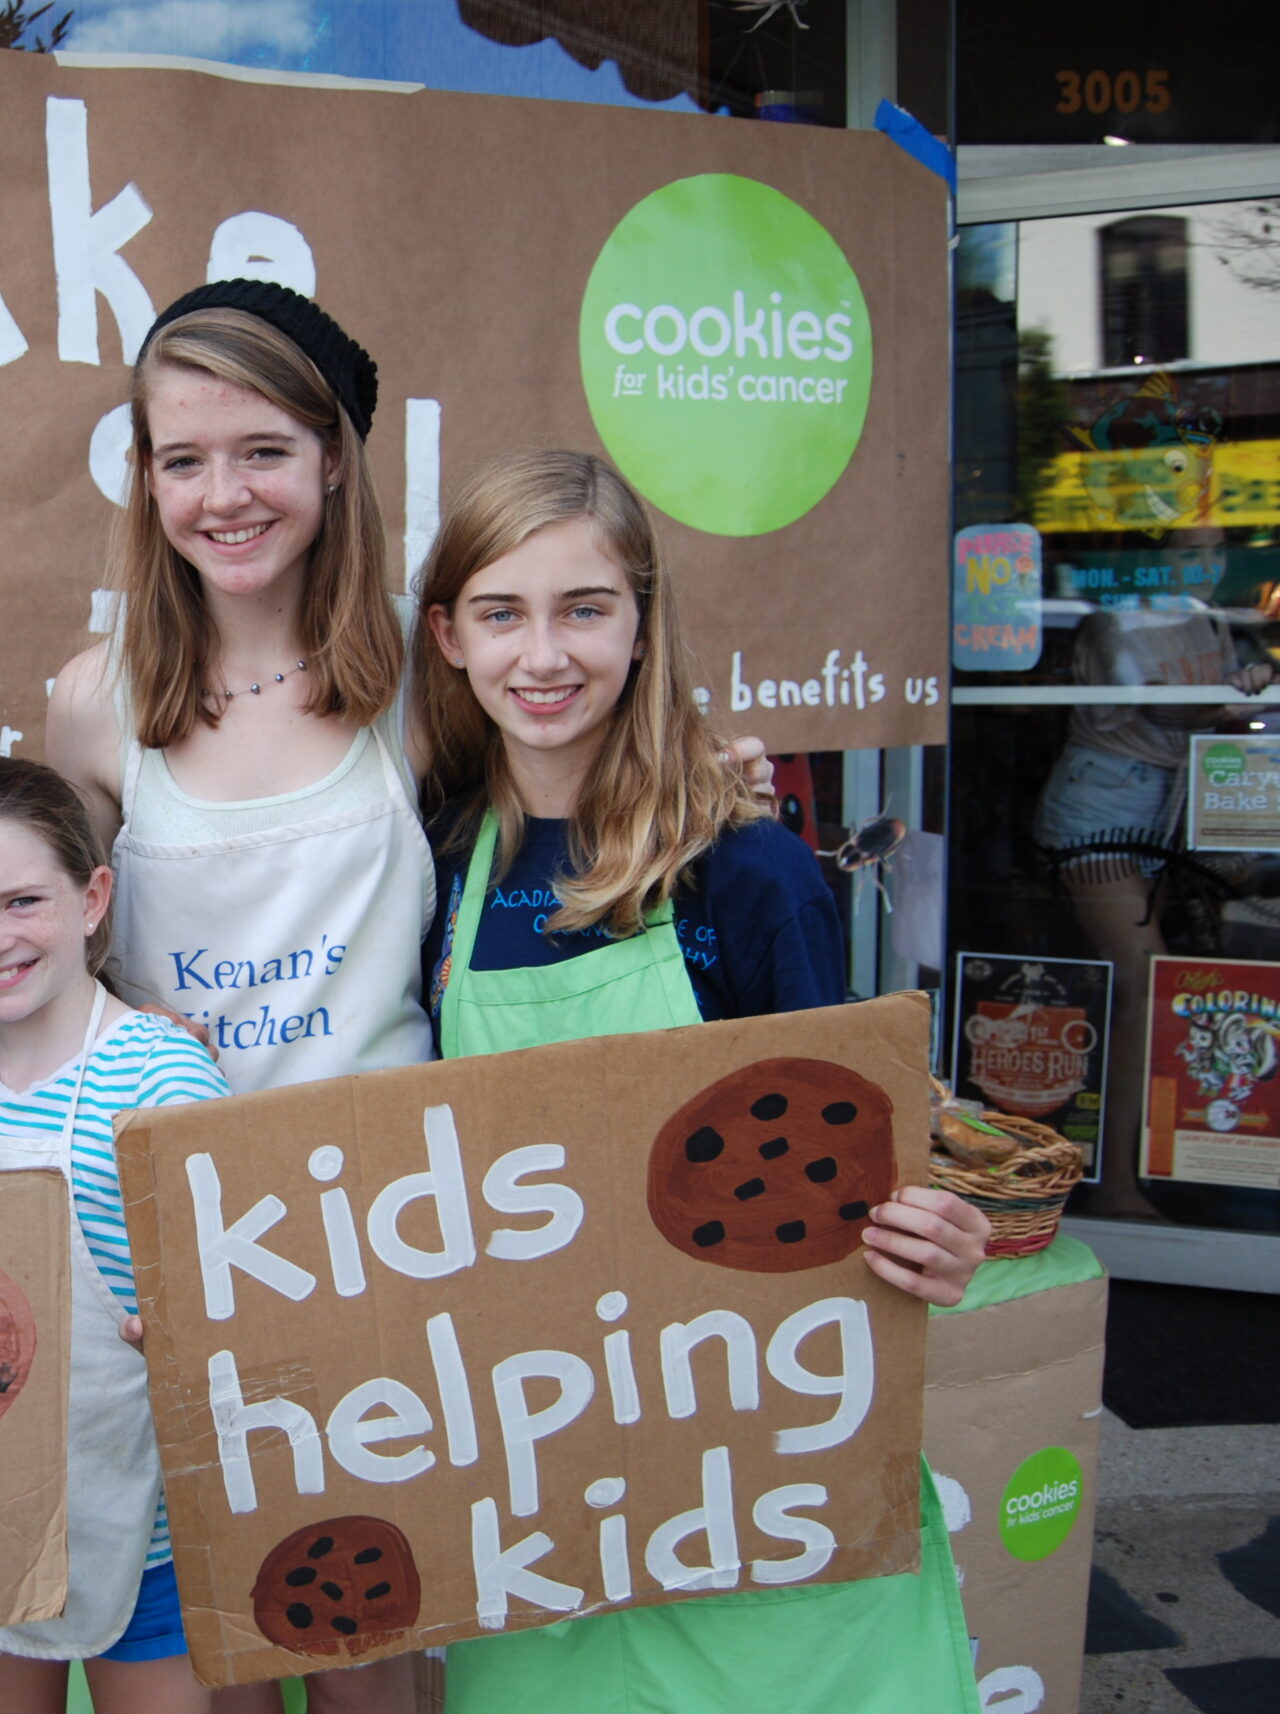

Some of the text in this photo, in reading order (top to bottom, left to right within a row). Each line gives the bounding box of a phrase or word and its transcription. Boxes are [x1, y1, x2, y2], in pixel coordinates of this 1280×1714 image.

[1055, 70, 1170, 114] 3005
[605, 289, 853, 362] cookies
[613, 364, 647, 398] for
[737, 374, 848, 404] cancer
[959, 531, 1034, 564] PLEASE
[966, 557, 1012, 595] NO
[1135, 566, 1177, 587] SAT.
[955, 624, 1038, 655] CREAM
[731, 650, 885, 711] benefits
[905, 677, 939, 706] us
[1205, 792, 1268, 811] Bake
[695, 926, 717, 946] OF
[168, 934, 347, 991] Kenan's
[1171, 989, 1280, 1021] COLORIN
[184, 1004, 334, 1050] itchen
[972, 1047, 1090, 1080] HEROES RUN
[184, 1102, 584, 1320] kids
[207, 1290, 875, 1516] helping
[1006, 1480, 1078, 1514] cookies
[1042, 1500, 1075, 1519] cancer
[470, 1445, 836, 1630] kids
